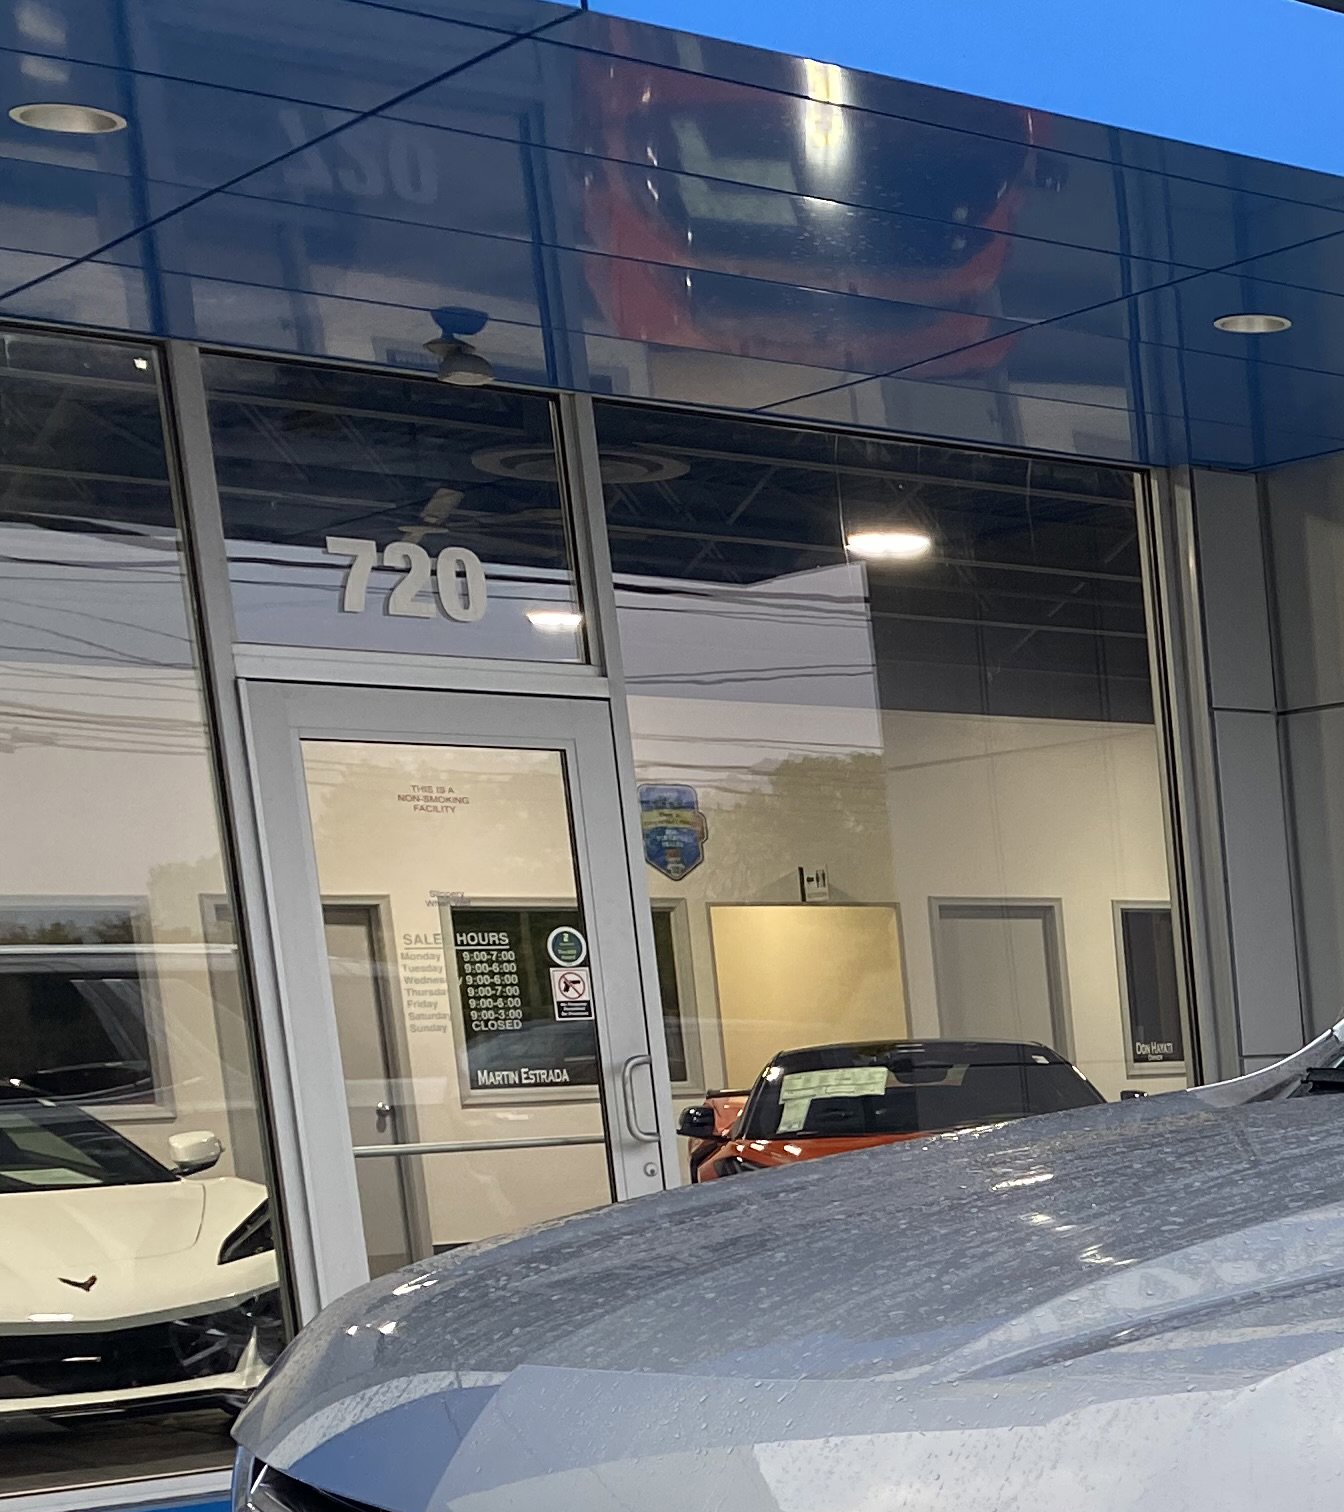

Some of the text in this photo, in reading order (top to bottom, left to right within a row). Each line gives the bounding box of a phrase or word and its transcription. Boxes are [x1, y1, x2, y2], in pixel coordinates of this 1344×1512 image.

[325, 535, 487, 623] 720
[410, 784, 455, 794] THIS IS A
[397, 794, 470, 805] NON-SMOKING
[413, 804, 456, 814] FACILITY
[403, 931, 509, 946] SALE HOURS
[400, 950, 516, 962] Monday 9:00-7:00
[402, 962, 517, 974] Tuesday 9:00-6:00
[465, 974, 519, 985] 9:00-6:00
[404, 985, 520, 997] Thursda 9:00-7:00
[407, 997, 521, 1011] Friday 9:00-6:00
[408, 1009, 523, 1021] Saturda 9:00-3:00
[409, 1019, 522, 1034] Sunday CLOSED
[477, 1067, 570, 1086] MARTIN ESTRADA
